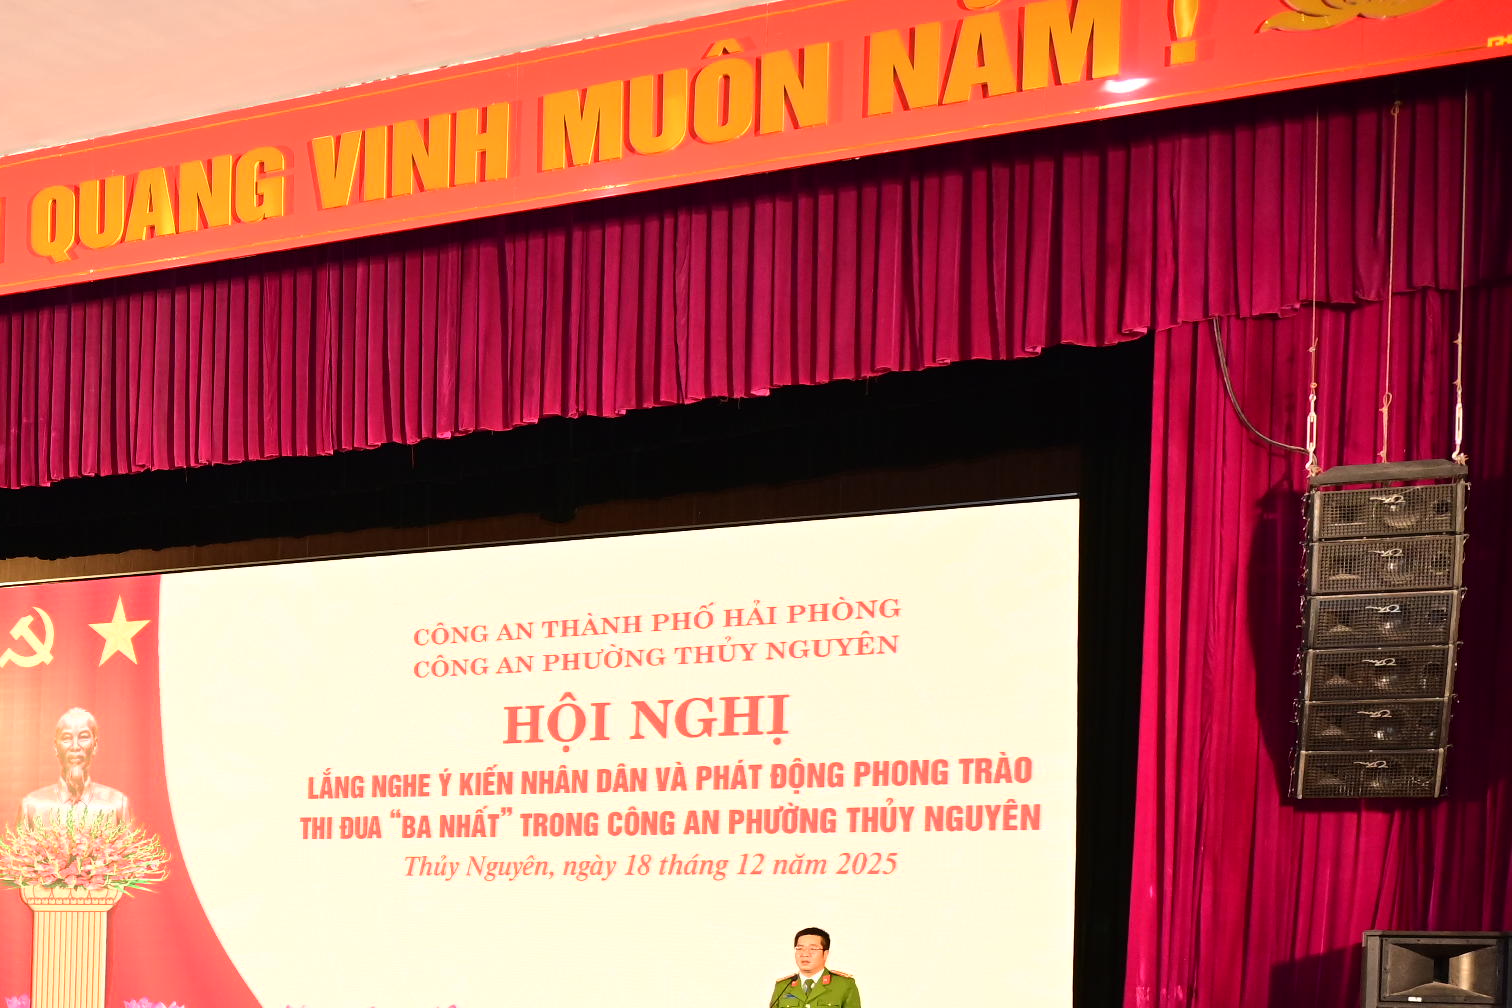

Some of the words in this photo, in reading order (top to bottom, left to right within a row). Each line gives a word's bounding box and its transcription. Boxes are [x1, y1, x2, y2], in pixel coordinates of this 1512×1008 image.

[30, 146, 285, 264] QUANG
[311, 102, 510, 210] VINH
[540, 38, 831, 174] MUÔN
[866, 0, 1120, 117] NĂM
[414, 622, 488, 646] CÔNG
[496, 622, 533, 641] AN
[542, 613, 642, 638] THÀNH
[651, 602, 714, 631] PHỐ
[723, 600, 777, 627] HẢI
[787, 597, 901, 623] PHÒNG
[414, 655, 488, 678] CÔNG
[496, 656, 534, 674] AN
[542, 644, 666, 671] PHƯỜNG
[674, 636, 758, 664] THỦY
[766, 631, 899, 660] NGUYÊN
[503, 692, 611, 752] HỘI
[630, 694, 790, 745] NGHỊ
[308, 768, 365, 799] LẮNG
[372, 774, 430, 797] NGHE
[439, 768, 451, 796] Ý
[459, 764, 513, 796] KIẾN
[521, 765, 588, 794] NHÂN
[597, 763, 647, 792] DÂN
[656, 762, 687, 791] VÀ
[696, 760, 763, 790] PHÁT
[770, 758, 844, 794] ĐỘNG
[854, 759, 948, 787] PHONG
[958, 752, 1032, 784] TRÀO
[300, 817, 332, 839] THI
[339, 816, 382, 839] ĐUA
[390, 809, 431, 838] “BA
[440, 806, 512, 838] NHẤT”
[520, 812, 599, 837] TRONG
[608, 806, 675, 836] CÔNG
[683, 810, 720, 835] AN
[729, 802, 836, 834] PHƯỜNG
[846, 798, 915, 832] THỦY
[925, 799, 1040, 832] NGUYÊN
[405, 855, 459, 881] Thủy
[466, 855, 554, 881] Nguyên,
[563, 855, 616, 881] ngày
[625, 855, 652, 875] 18
[659, 854, 729, 881] tháng
[737, 853, 764, 874] 12
[773, 854, 826, 874] năm
[836, 853, 898, 874] 2025
